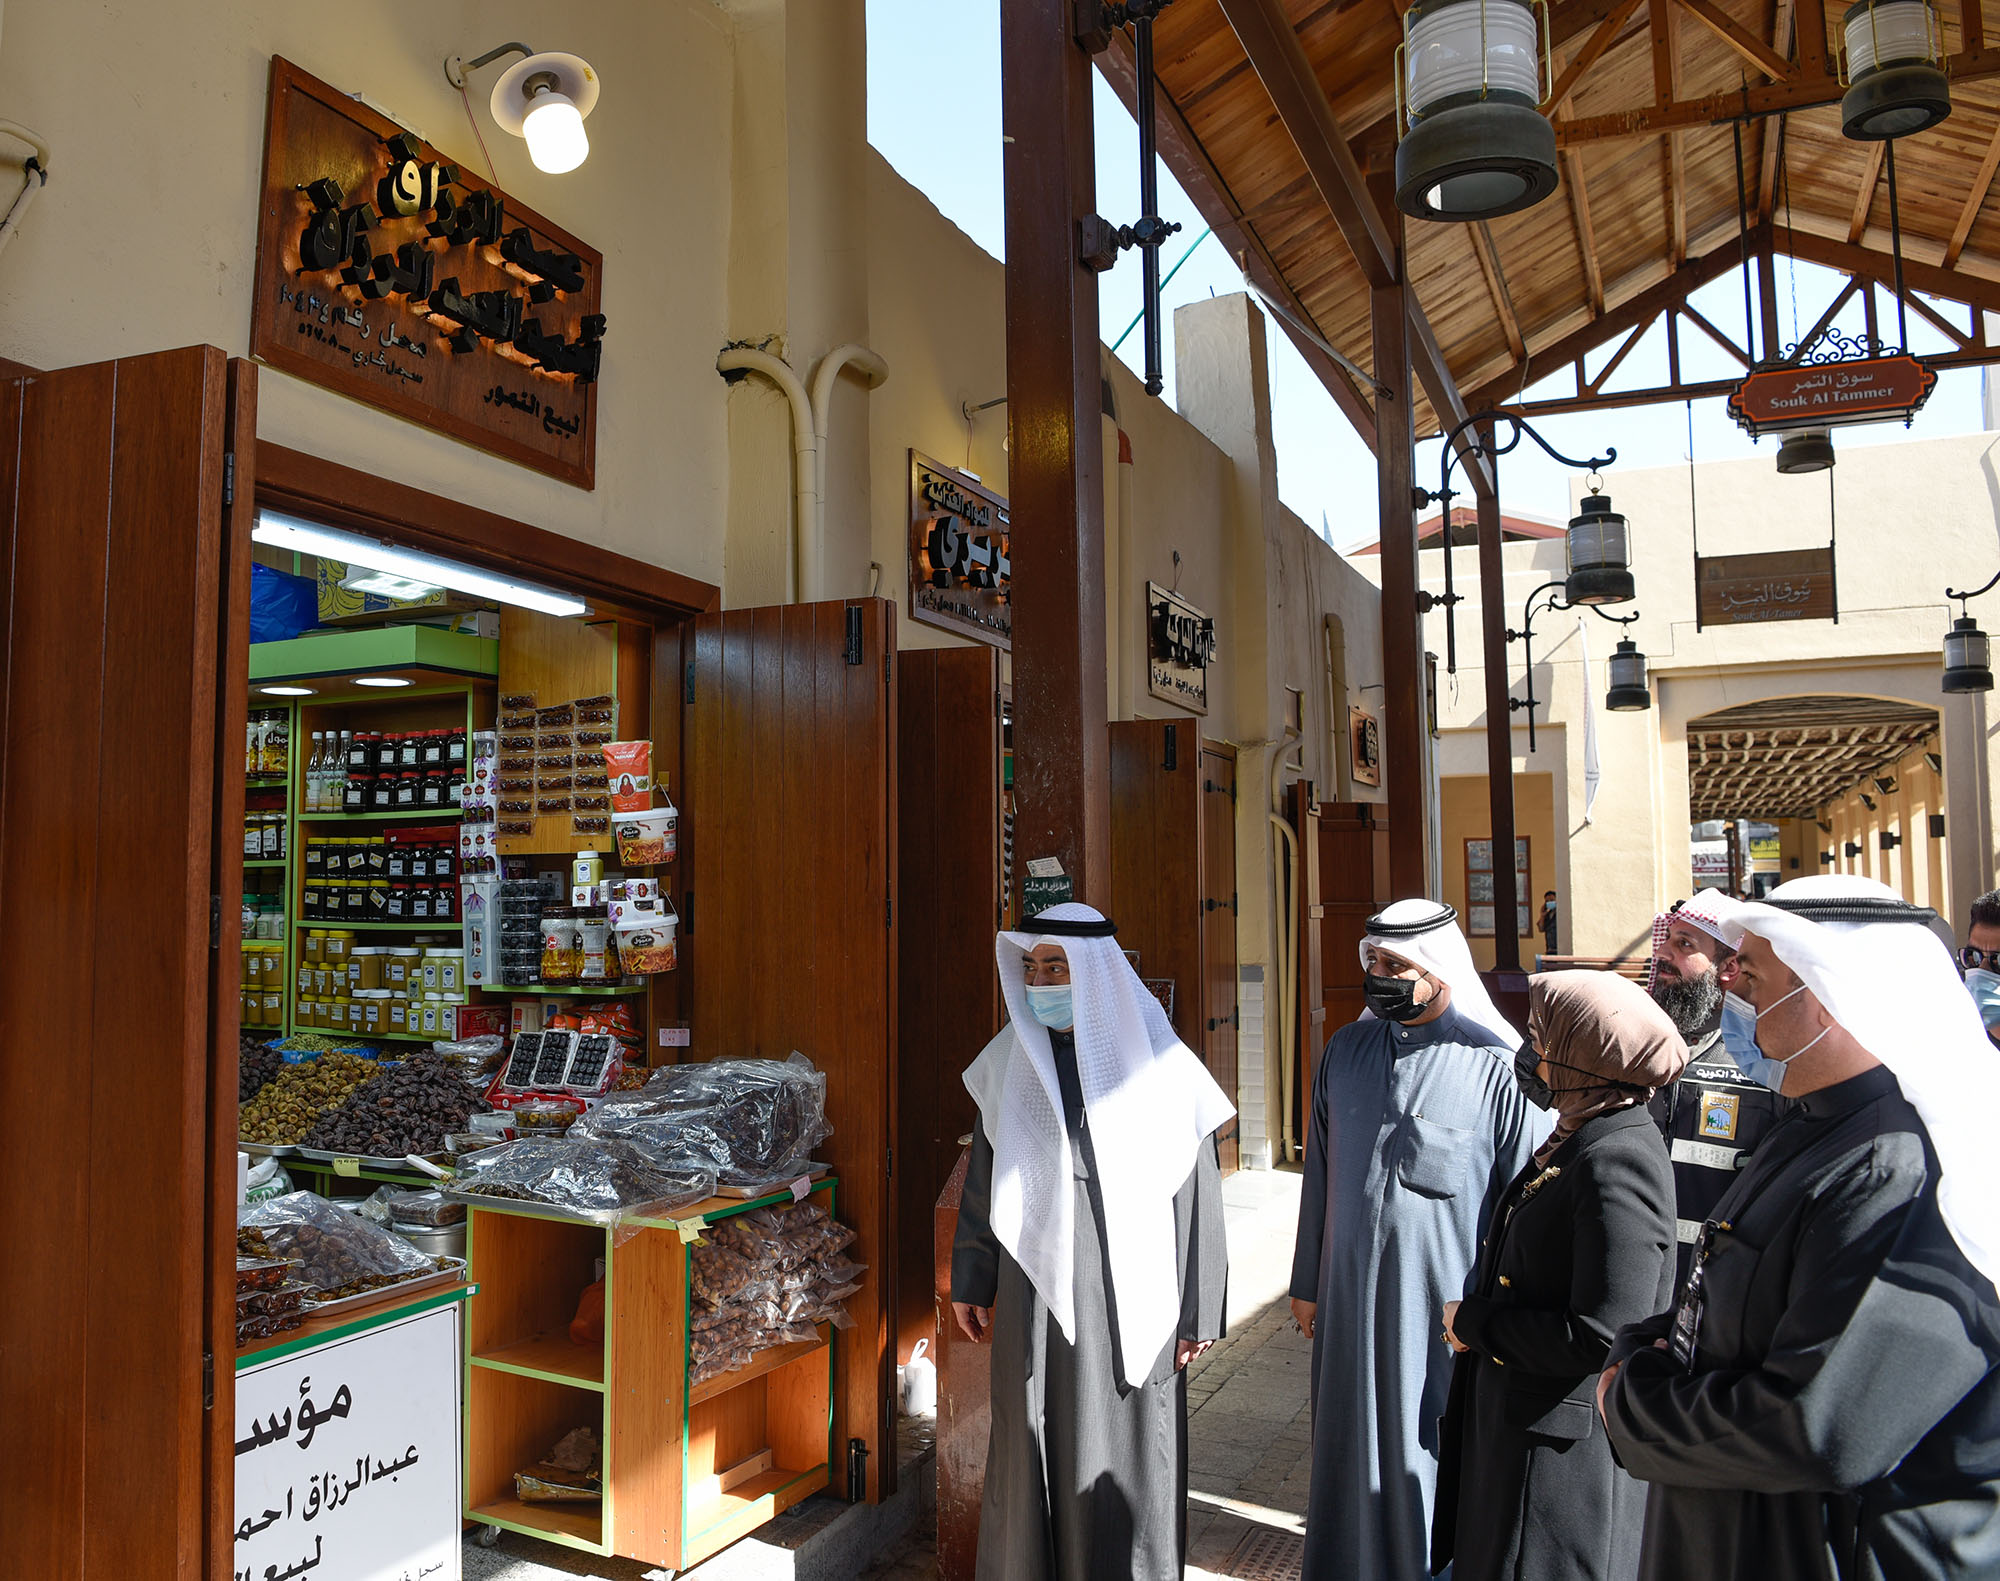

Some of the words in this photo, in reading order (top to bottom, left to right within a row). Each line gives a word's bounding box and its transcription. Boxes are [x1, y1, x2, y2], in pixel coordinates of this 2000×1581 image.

[331, 299, 371, 340] رقم
[379, 322, 427, 358] محل
[352, 350, 388, 372] تجاري
[386, 360, 424, 384] سجل
[1792, 374, 1832, 393] التمر
[1836, 372, 1874, 388] سوق
[483, 385, 540, 418] التمور
[1770, 395, 1808, 409] Souk
[1812, 392, 1829, 404] Al
[1832, 387, 1894, 402] Tammer
[543, 405, 580, 439] لبيع
[235, 1376, 352, 1456] مؤس
[234, 1486, 293, 1542] احم
